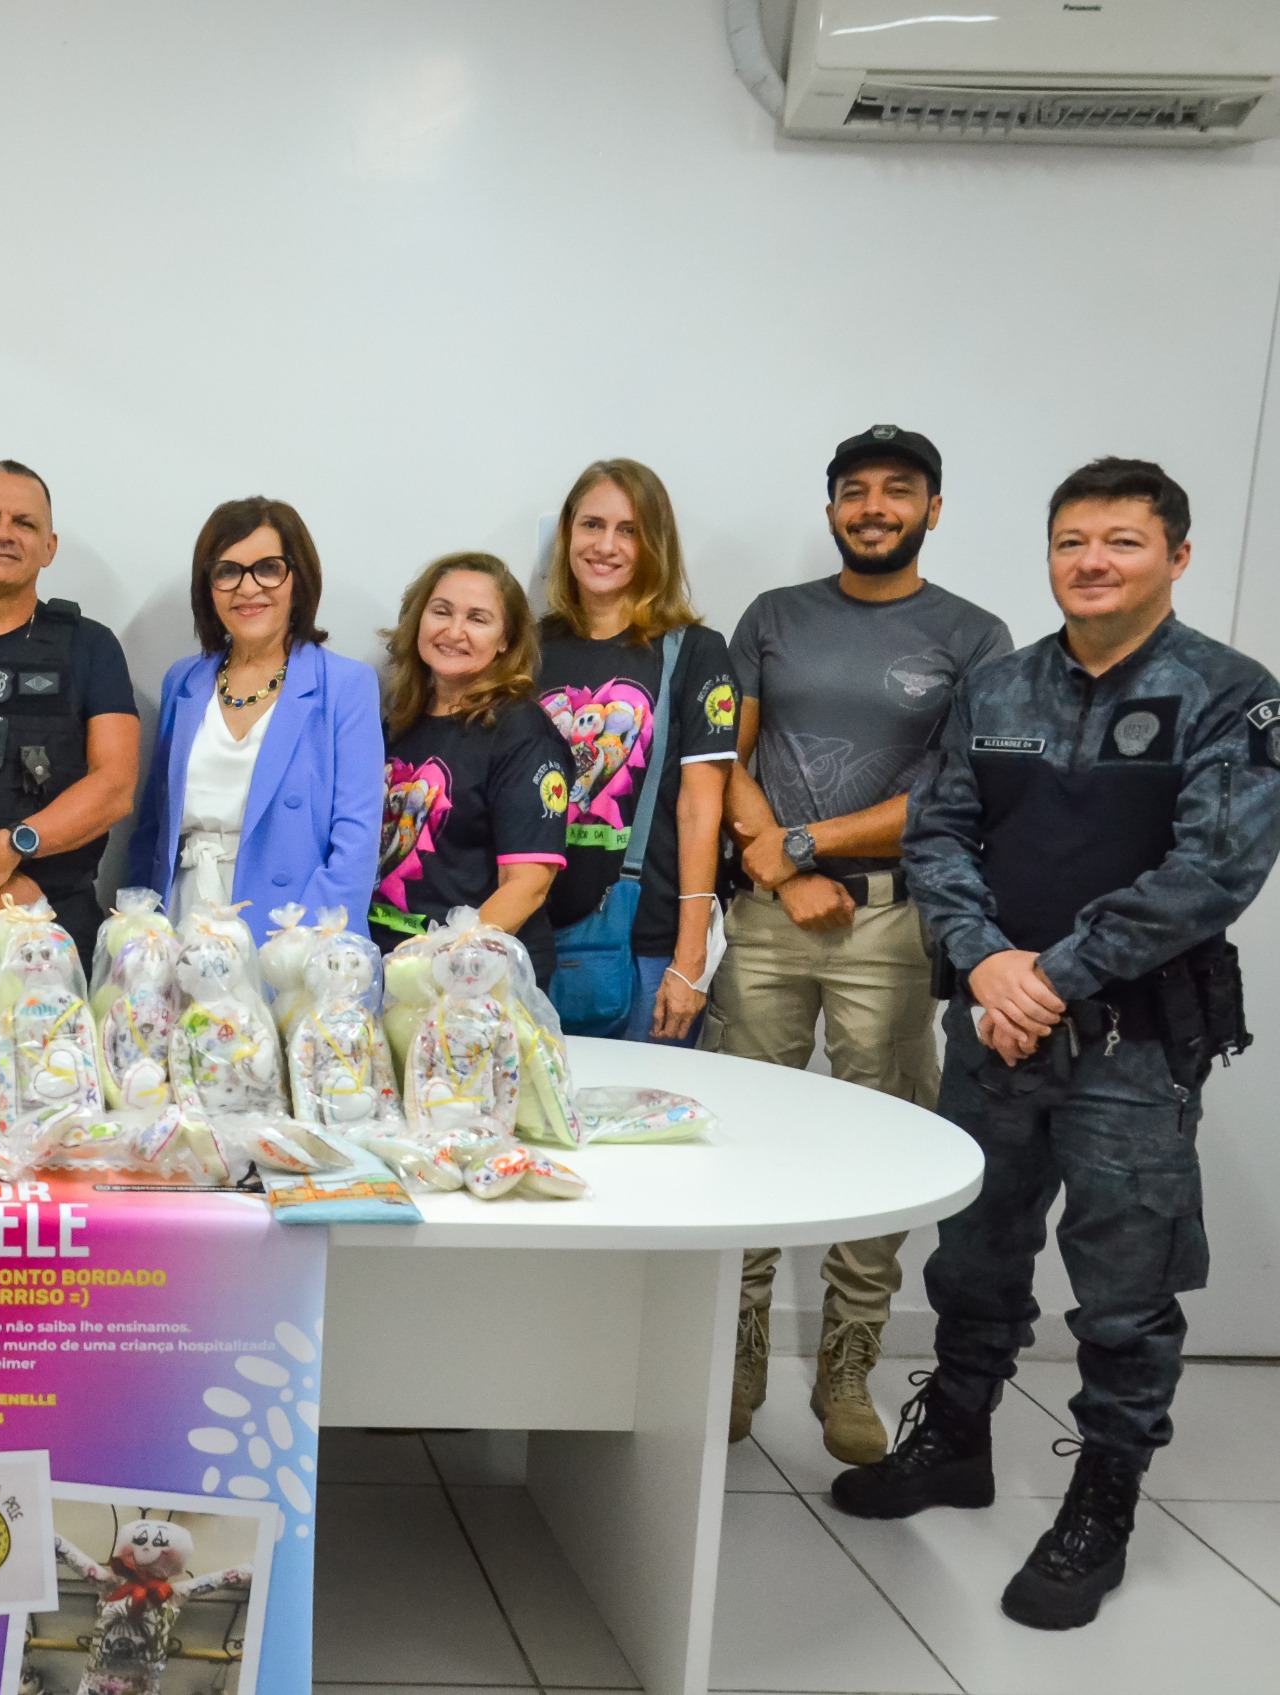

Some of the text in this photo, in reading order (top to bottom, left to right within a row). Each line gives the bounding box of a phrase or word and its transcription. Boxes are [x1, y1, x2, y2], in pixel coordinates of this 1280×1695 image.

[984, 740, 1022, 748] ALEXANDRE
[594, 830, 604, 839] DA
[61, 1269, 167, 1287] BORDADO
[5, 1320, 34, 1332] não
[37, 1320, 76, 1333] saiba
[80, 1320, 103, 1333] lhe
[107, 1321, 191, 1334] ensinamos.
[3, 1339, 57, 1351] mundo
[60, 1339, 79, 1351] de
[83, 1341, 116, 1351] uma
[120, 1339, 174, 1354] criança
[178, 1339, 276, 1353] hospitalizada
[2, 1495, 24, 1522] PELE
